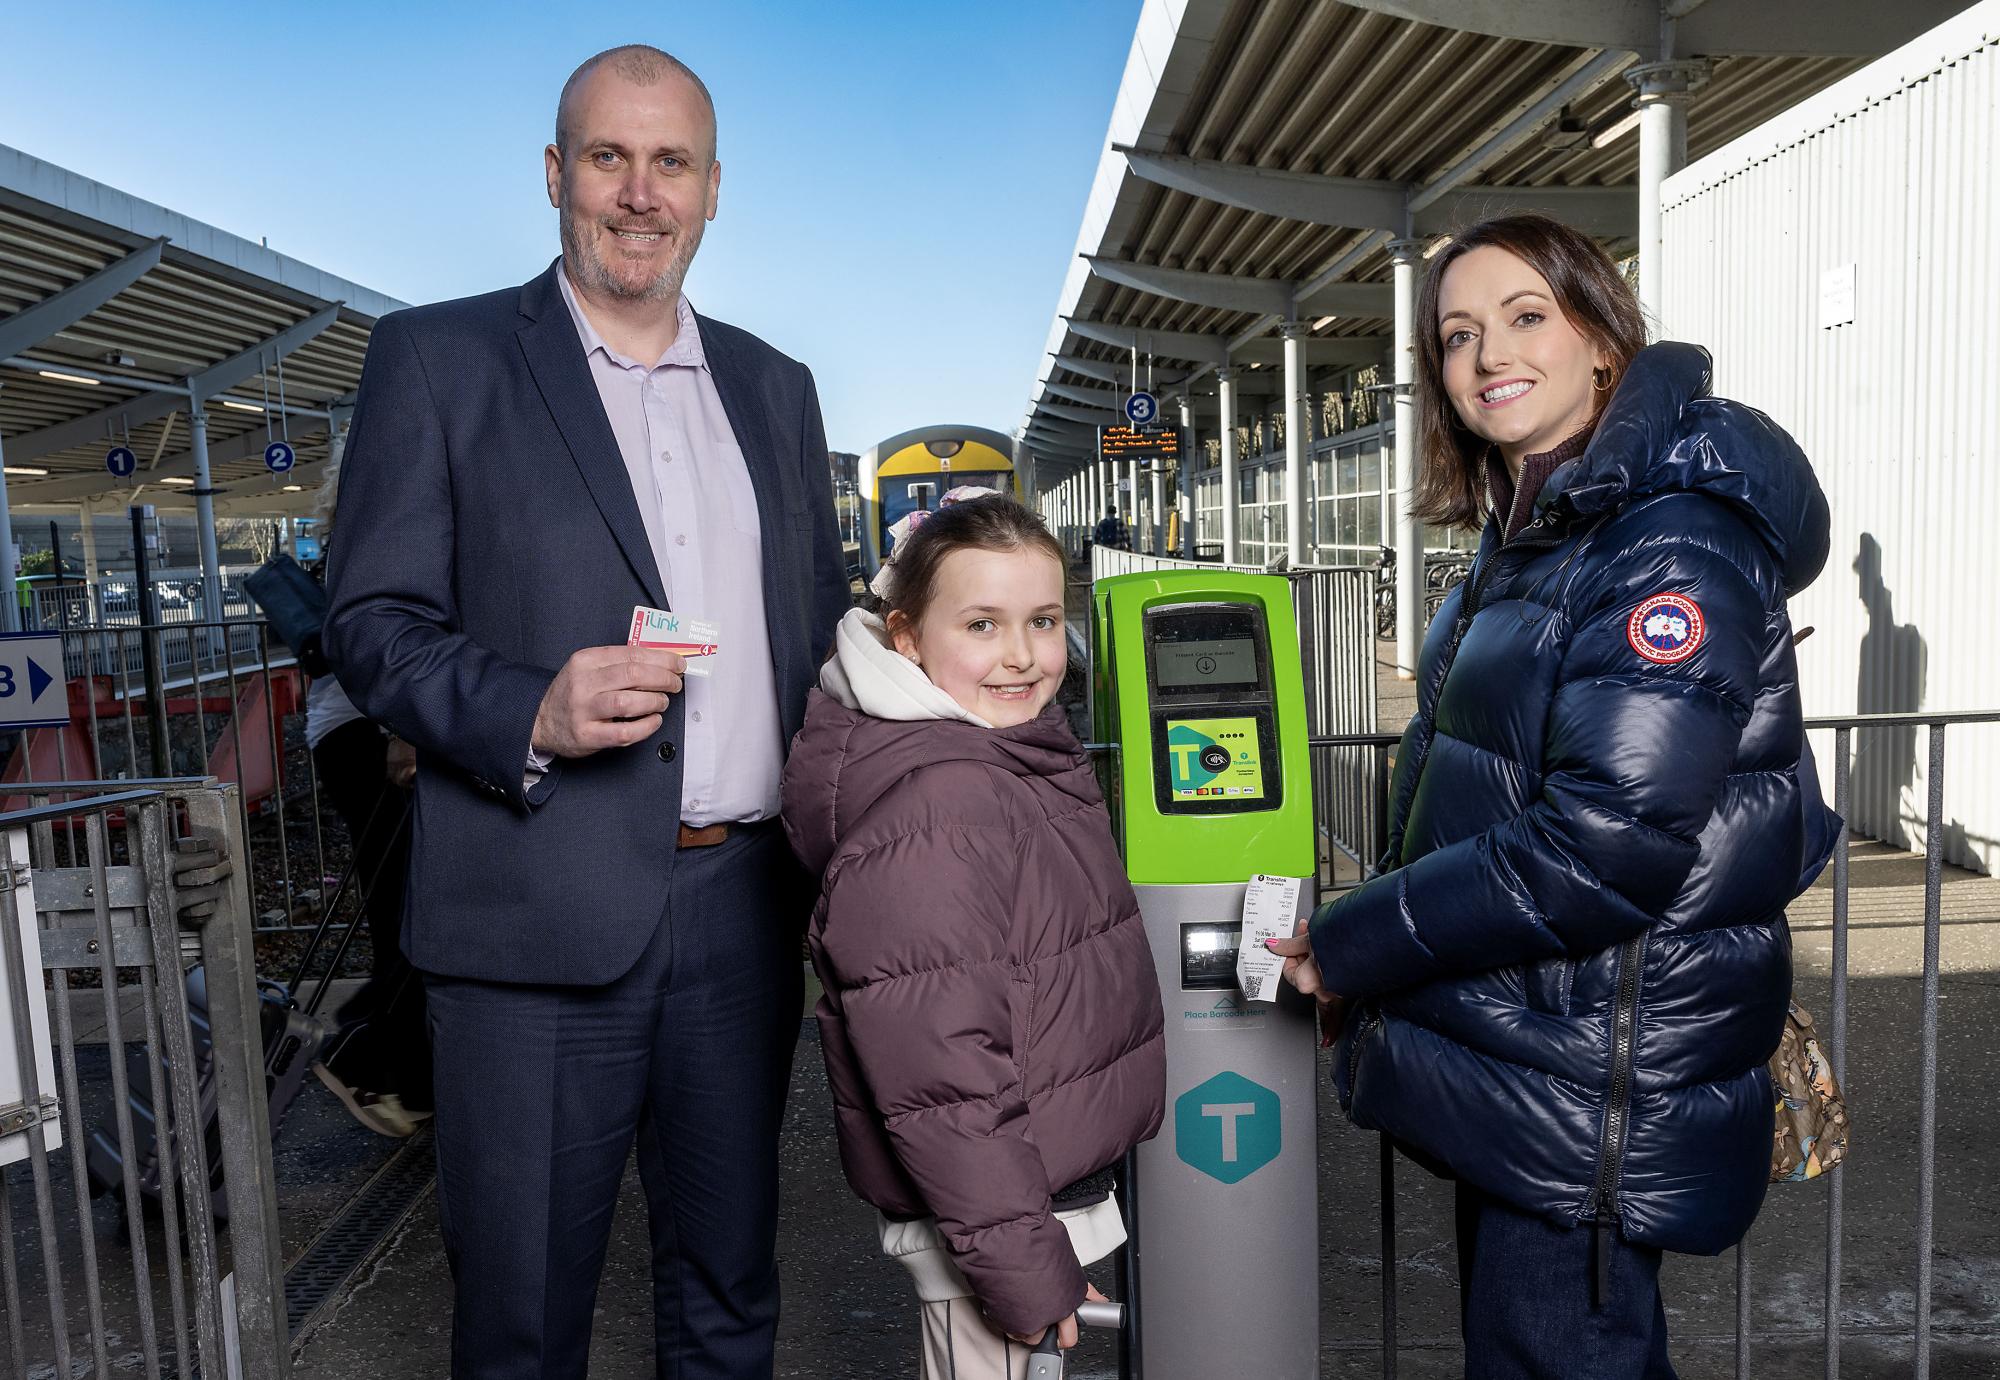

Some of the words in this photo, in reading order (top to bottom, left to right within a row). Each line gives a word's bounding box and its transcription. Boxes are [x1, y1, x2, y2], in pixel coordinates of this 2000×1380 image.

[1133, 398, 1150, 418] 3
[113, 453, 124, 471] 1
[271, 448, 287, 467] 2
[1641, 597, 1672, 612] CANADA
[1673, 598, 1695, 615] GOOSE
[645, 611, 680, 633] iLink
[689, 624, 718, 637] Northern
[688, 631, 711, 643] Ireland
[702, 645, 709, 656] 4
[1634, 638, 1656, 656] ARCTIC
[1656, 645, 1690, 659] PROGRAM
[1184, 1010, 1208, 1019] Place
[1209, 1010, 1245, 1018] Barcode
[1246, 1008, 1265, 1017] Here
[1201, 1103, 1255, 1162] T
